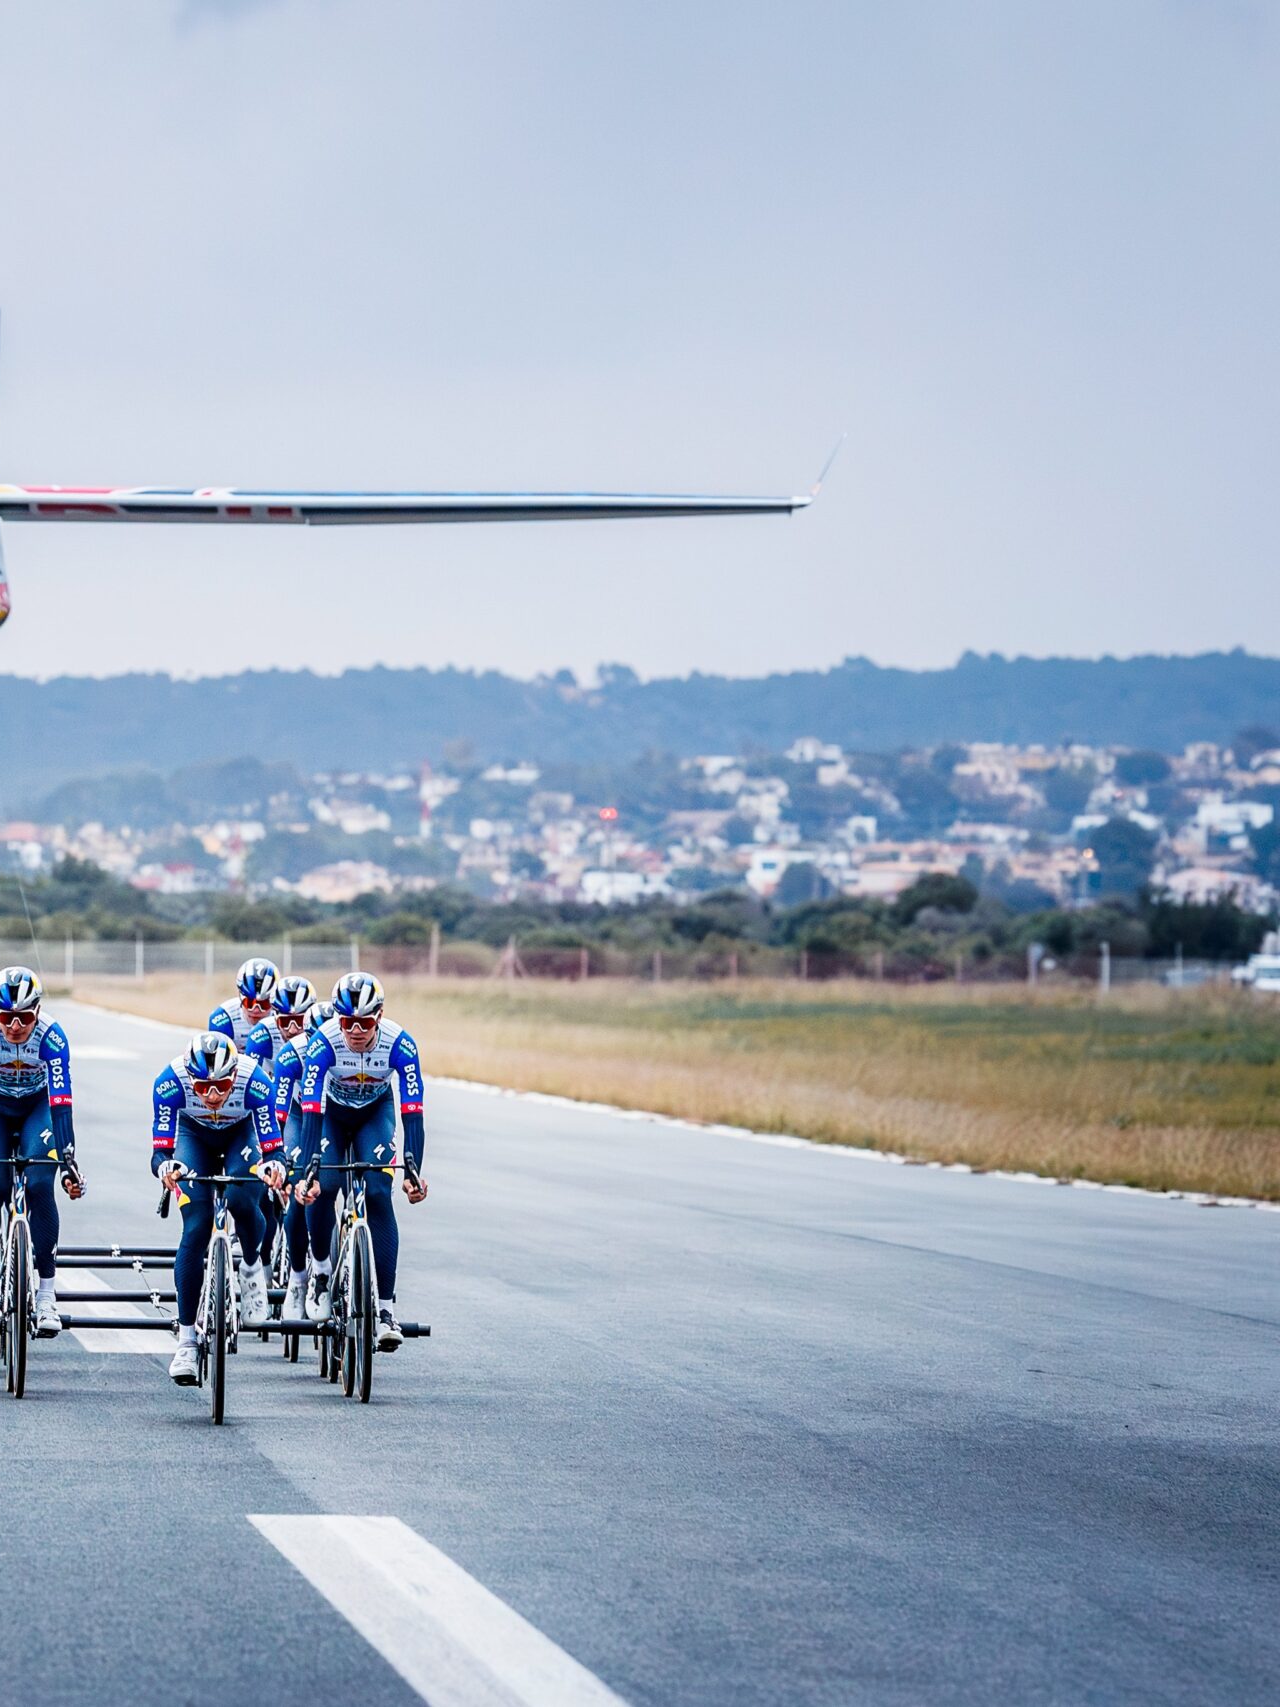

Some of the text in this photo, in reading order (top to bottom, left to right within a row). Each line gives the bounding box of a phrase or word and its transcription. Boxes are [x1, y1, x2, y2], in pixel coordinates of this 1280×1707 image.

[211, 1012, 227, 1025] BORA
[49, 1030, 65, 1049] BORA
[250, 1028, 268, 1041] BORA
[306, 1038, 324, 1056] BORA
[400, 1038, 417, 1055] BORA
[278, 1050, 296, 1063] BORA
[49, 1057, 65, 1089] BOSS
[303, 1064, 320, 1096] BOSS
[403, 1063, 419, 1096] BOSS
[155, 1080, 177, 1095] BORA
[250, 1080, 270, 1096] BORA
[275, 1076, 291, 1105] BOSS
[157, 1104, 171, 1132] BOSS
[256, 1105, 273, 1135] BOSS
